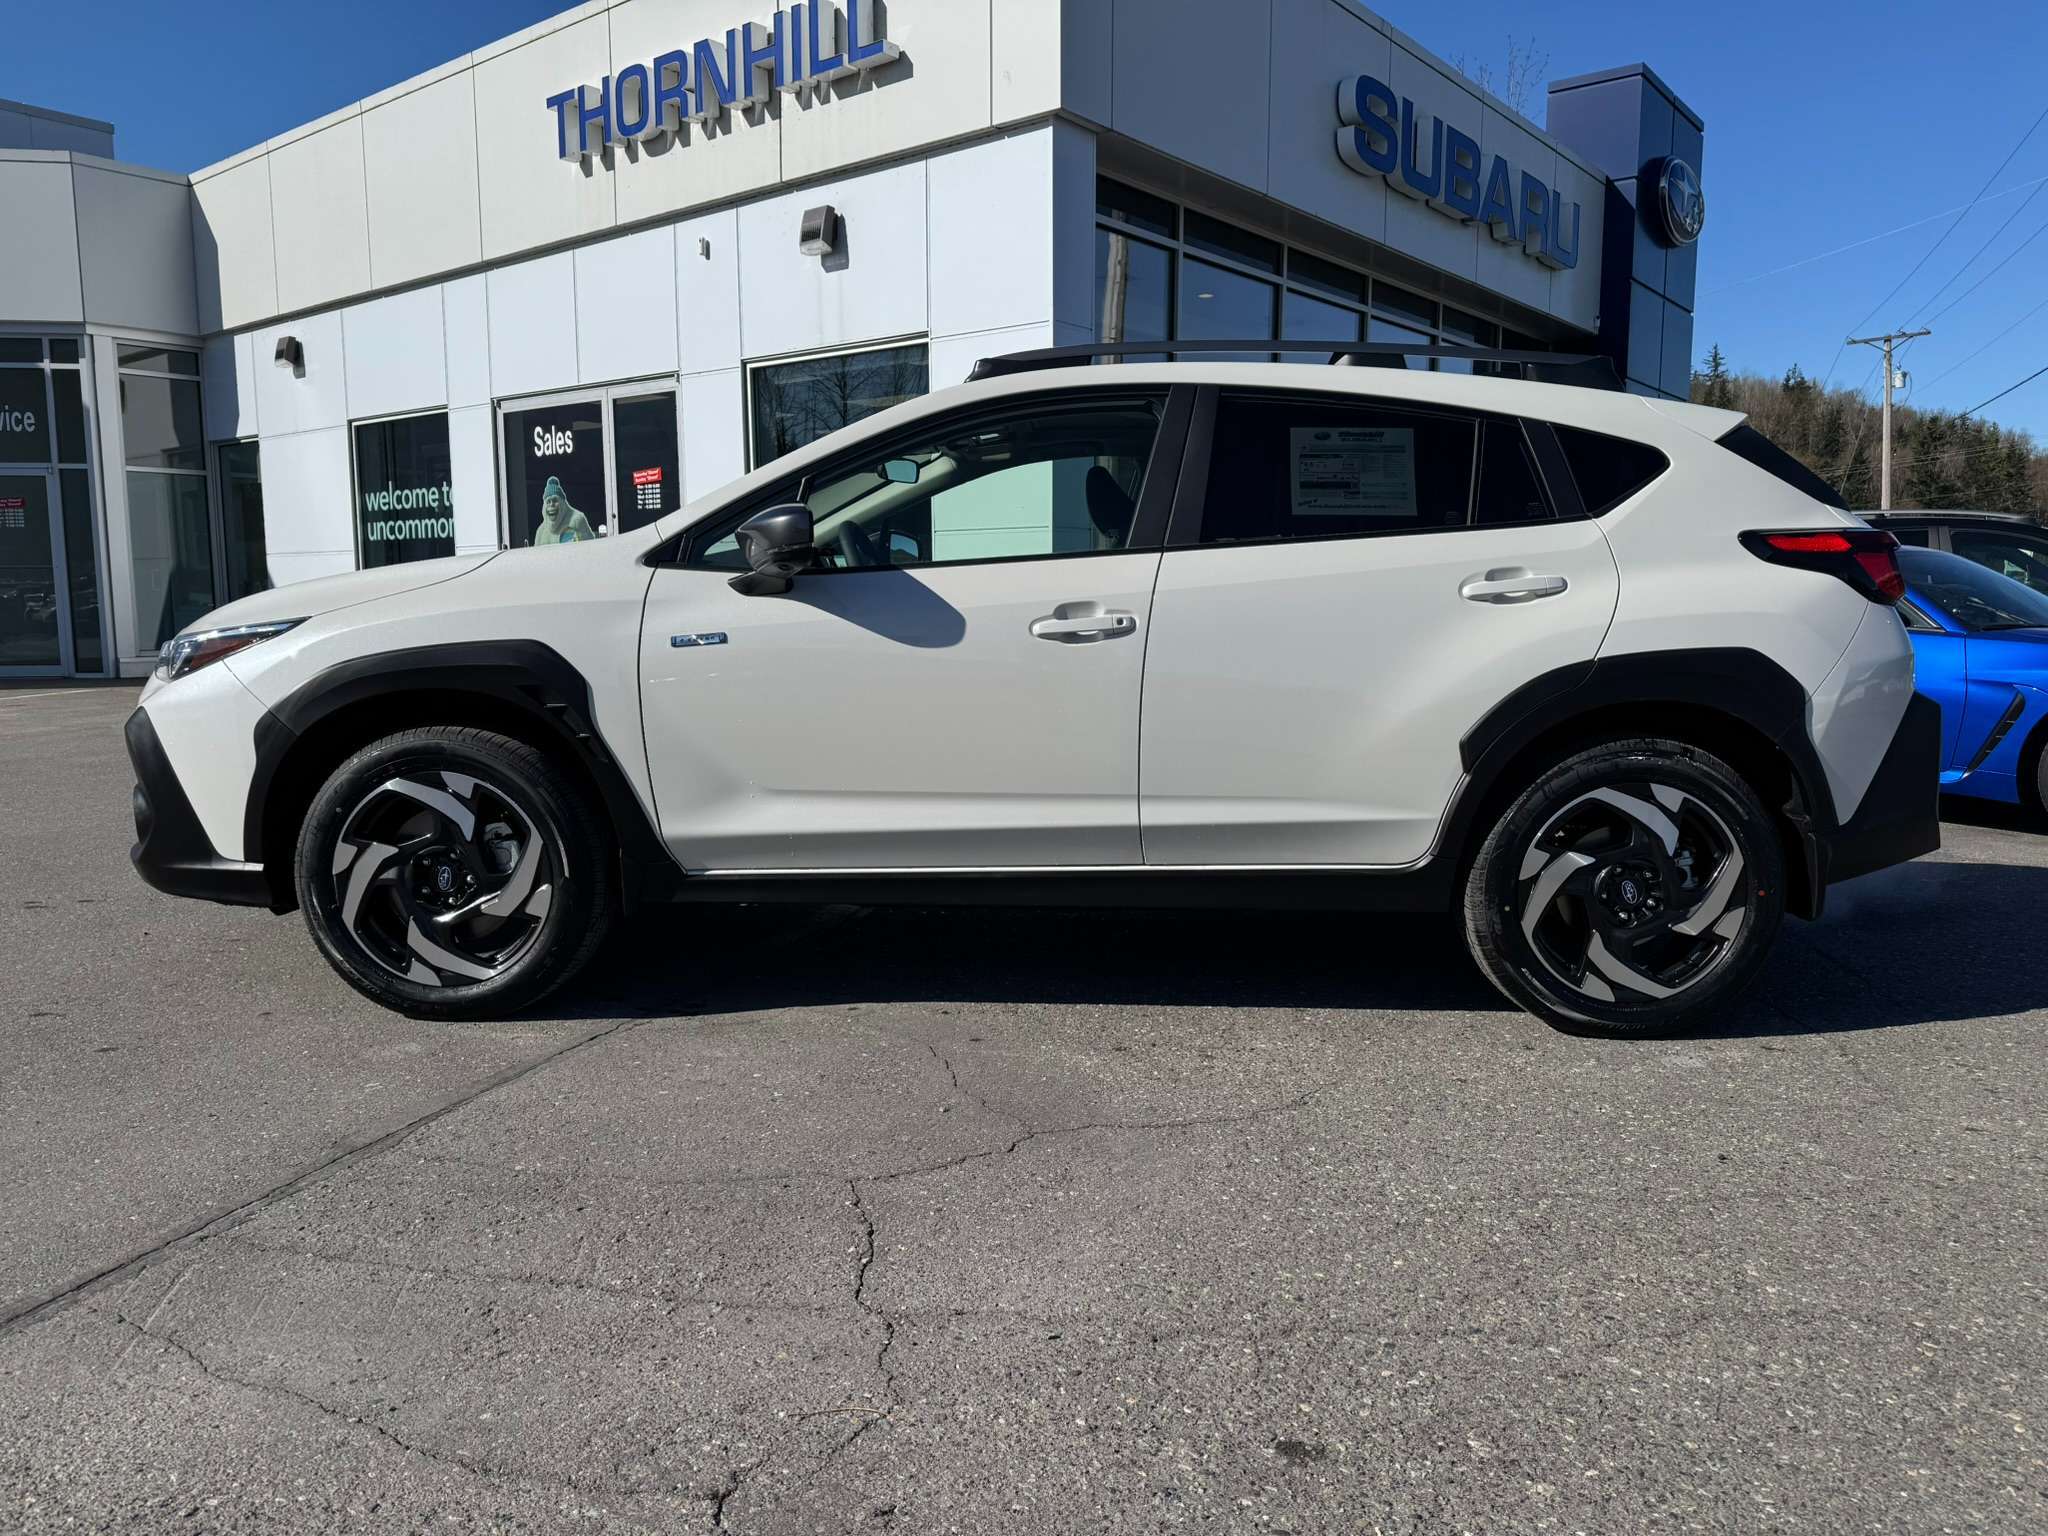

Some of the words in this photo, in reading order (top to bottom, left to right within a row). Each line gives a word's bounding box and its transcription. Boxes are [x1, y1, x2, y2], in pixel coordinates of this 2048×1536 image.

[546, 0, 886, 161] THORNHILL
[1352, 74, 1581, 270] SUBARU
[534, 424, 574, 457] Sales
[365, 480, 440, 512] welcome
